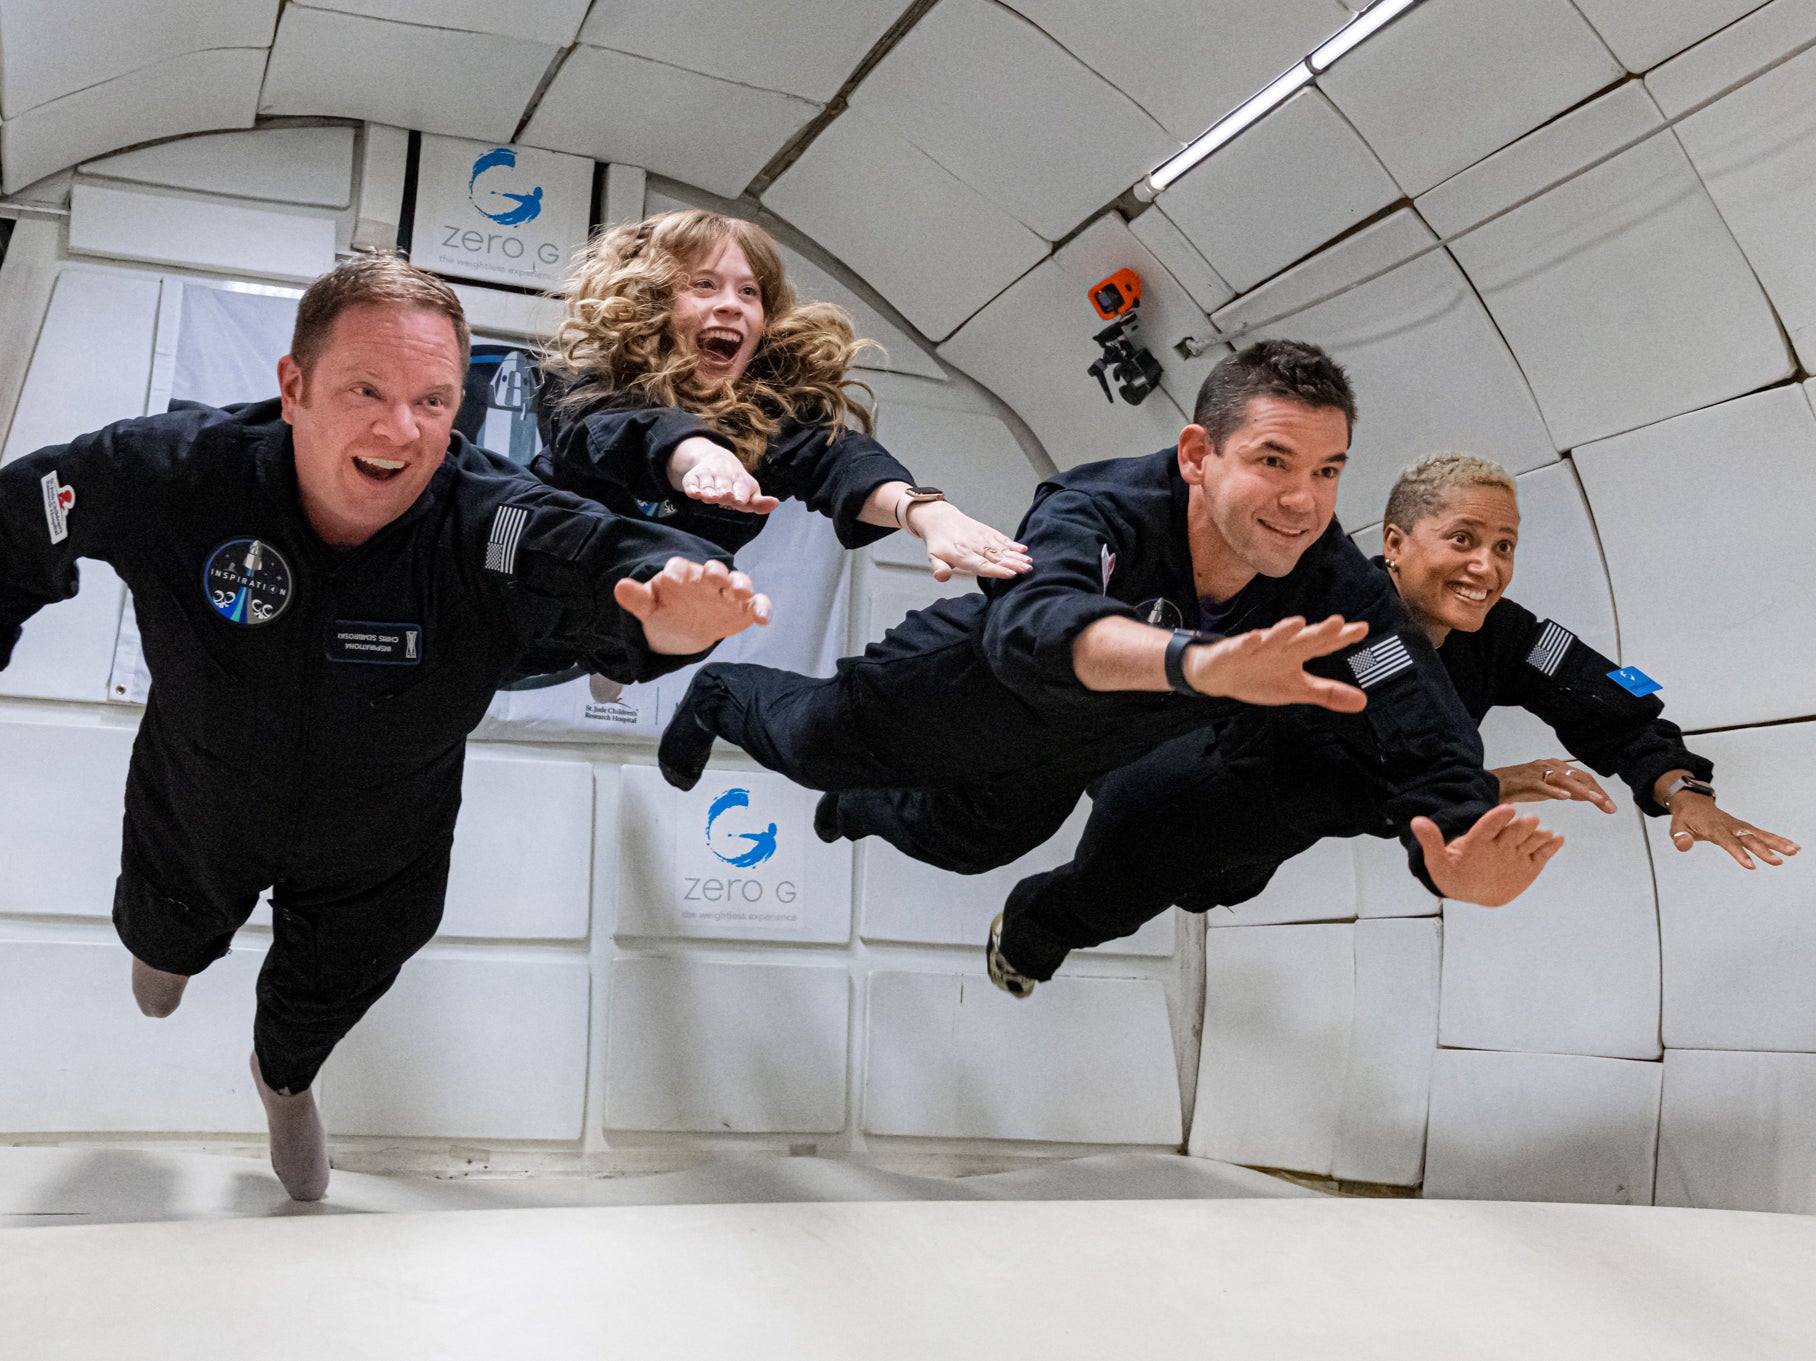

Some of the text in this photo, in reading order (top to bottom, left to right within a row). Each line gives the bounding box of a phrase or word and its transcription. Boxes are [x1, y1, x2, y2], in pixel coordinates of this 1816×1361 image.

[441, 225, 560, 265] zero G
[439, 255, 455, 265] the
[457, 258, 506, 273] weightless
[594, 705, 607, 713] Jude
[585, 711, 637, 724] Research Hospital
[683, 877, 797, 904] zero G
[681, 910, 797, 922] the weightless experience
